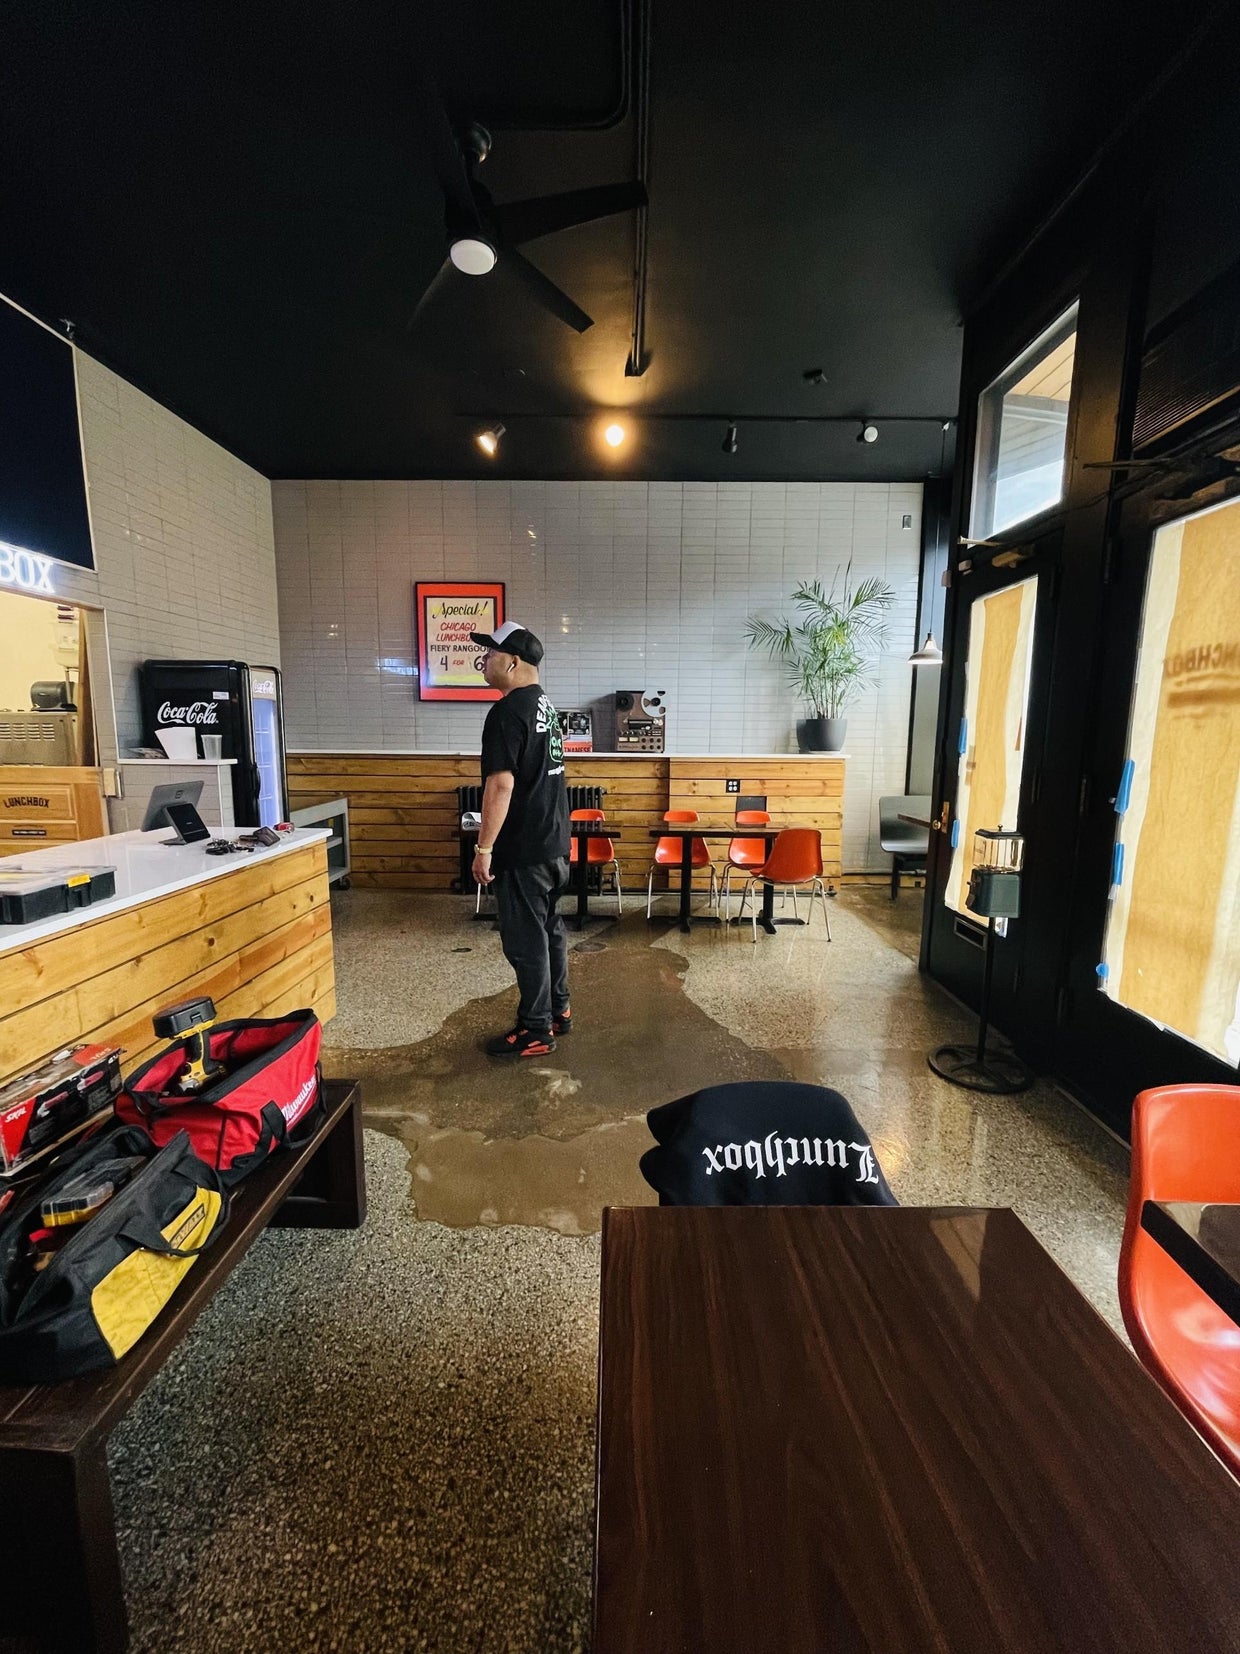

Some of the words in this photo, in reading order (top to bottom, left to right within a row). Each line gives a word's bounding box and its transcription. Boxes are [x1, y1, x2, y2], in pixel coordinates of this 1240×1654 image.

[432, 601, 488, 618] Special!
[440, 622, 477, 631] CHICAGO
[436, 634, 472, 642] LUNCHBO
[440, 655, 448, 671] 4
[157, 701, 219, 724] Coca-Cola
[3, 796, 50, 808] LUNCHBOX
[702, 1130, 879, 1184] Lunchbox
